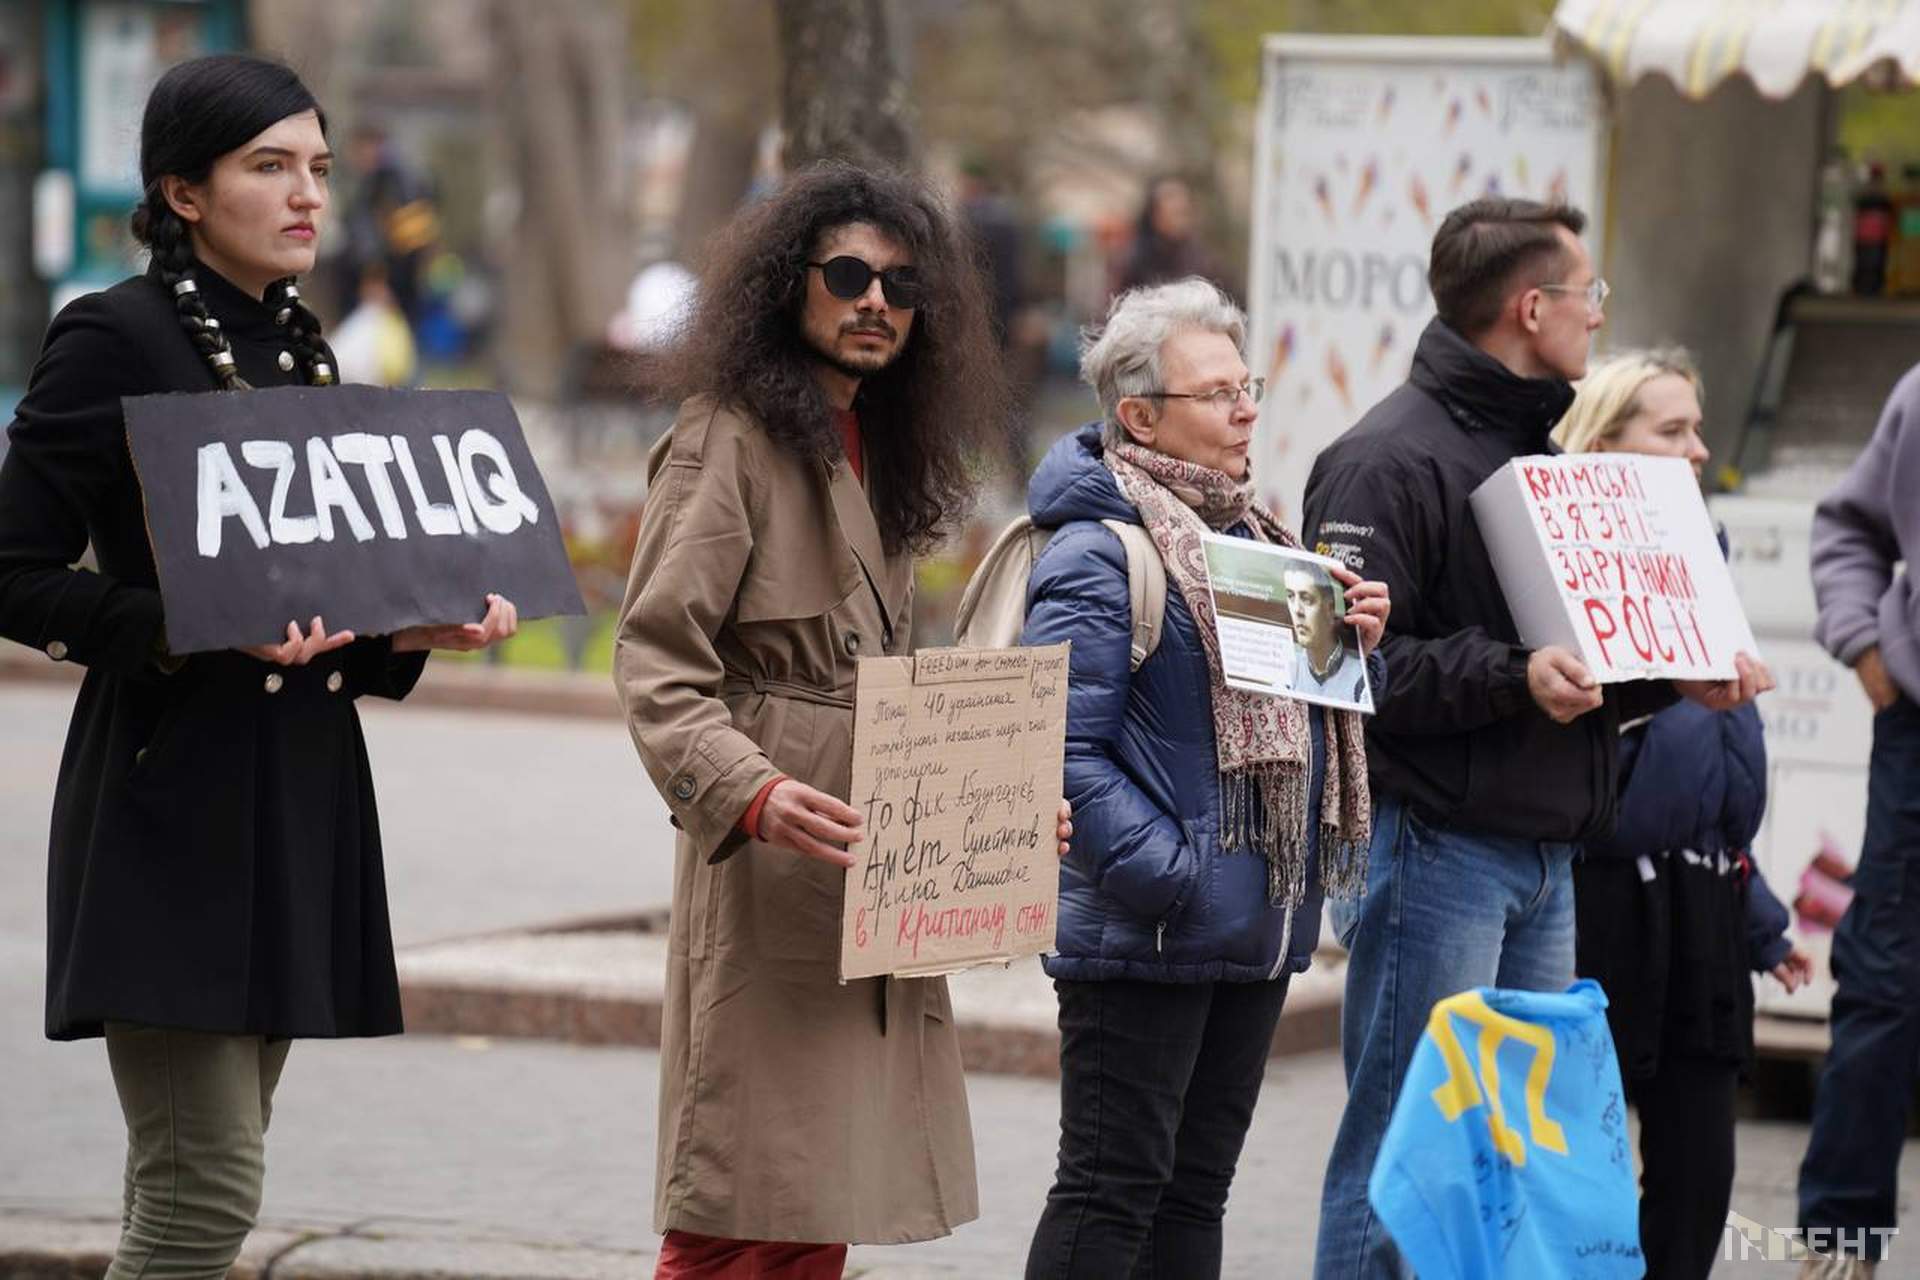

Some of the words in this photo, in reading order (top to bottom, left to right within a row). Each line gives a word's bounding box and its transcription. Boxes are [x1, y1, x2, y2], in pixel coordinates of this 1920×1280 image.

[197, 429, 539, 558] AZATLIQ
[1523, 463, 1646, 501] КРИМСЬКІ
[1557, 549, 1698, 600] ЗАРУЧНИКИ
[924, 691, 946, 721] 40
